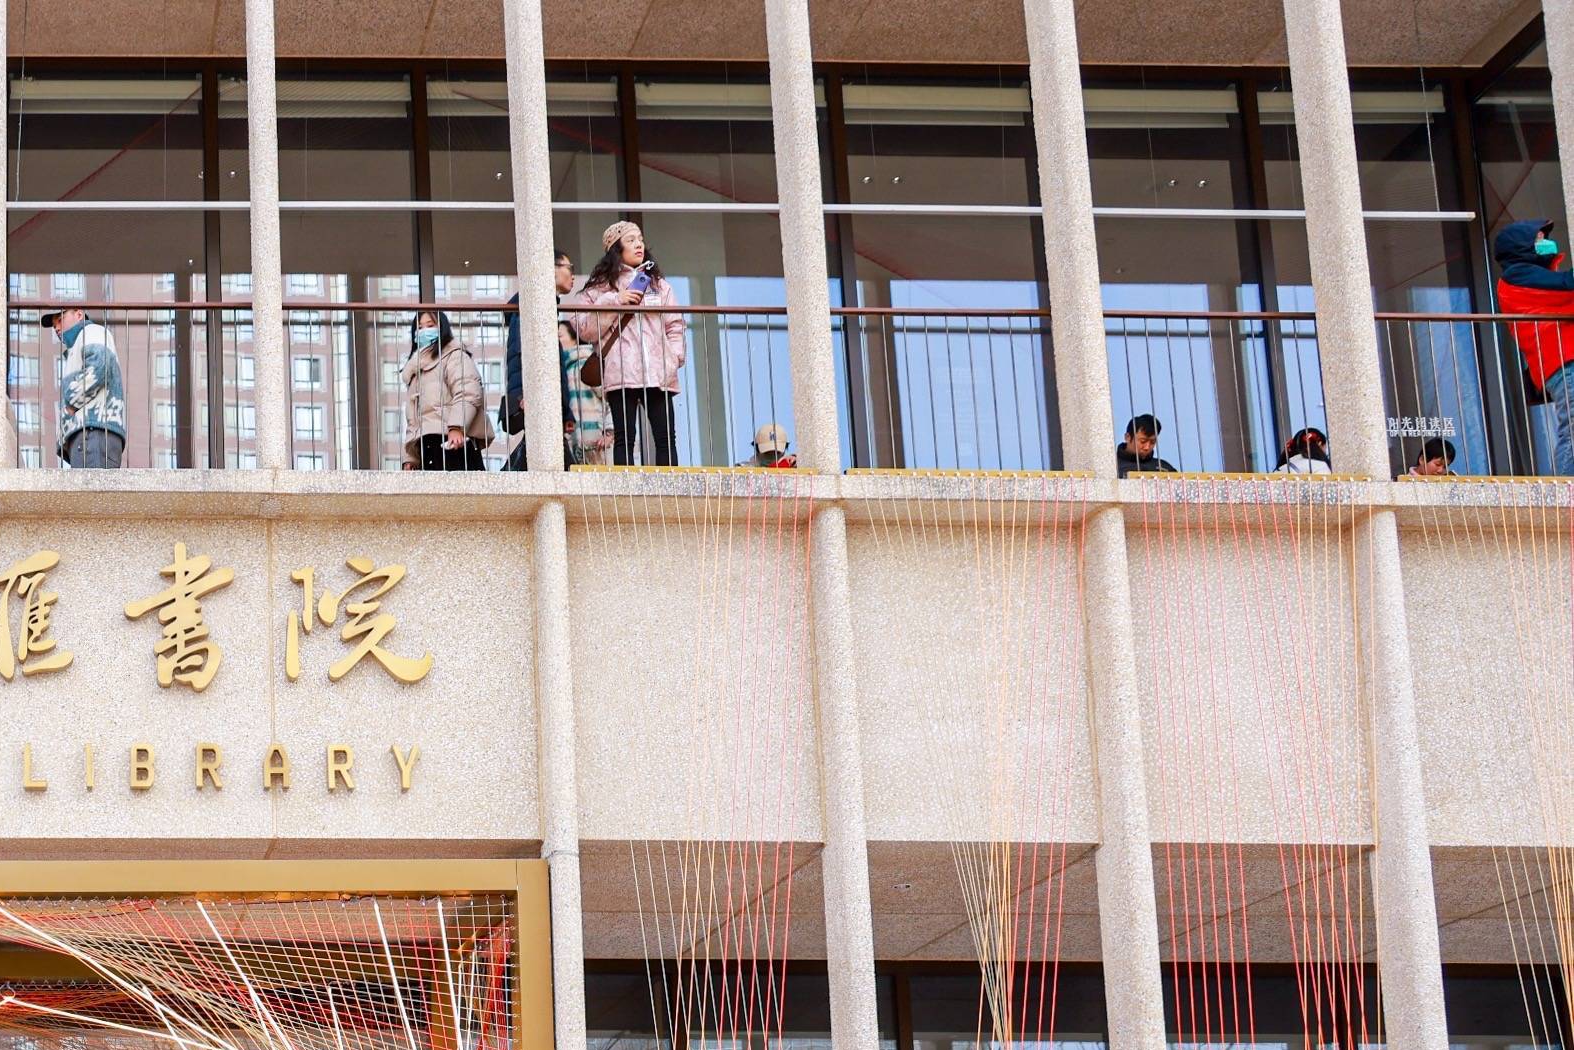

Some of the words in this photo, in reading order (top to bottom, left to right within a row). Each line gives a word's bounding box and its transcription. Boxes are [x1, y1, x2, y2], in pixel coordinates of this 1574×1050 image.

[1386, 416, 1456, 431] 阳光阅读区
[21, 741, 422, 793] LIBRARY
